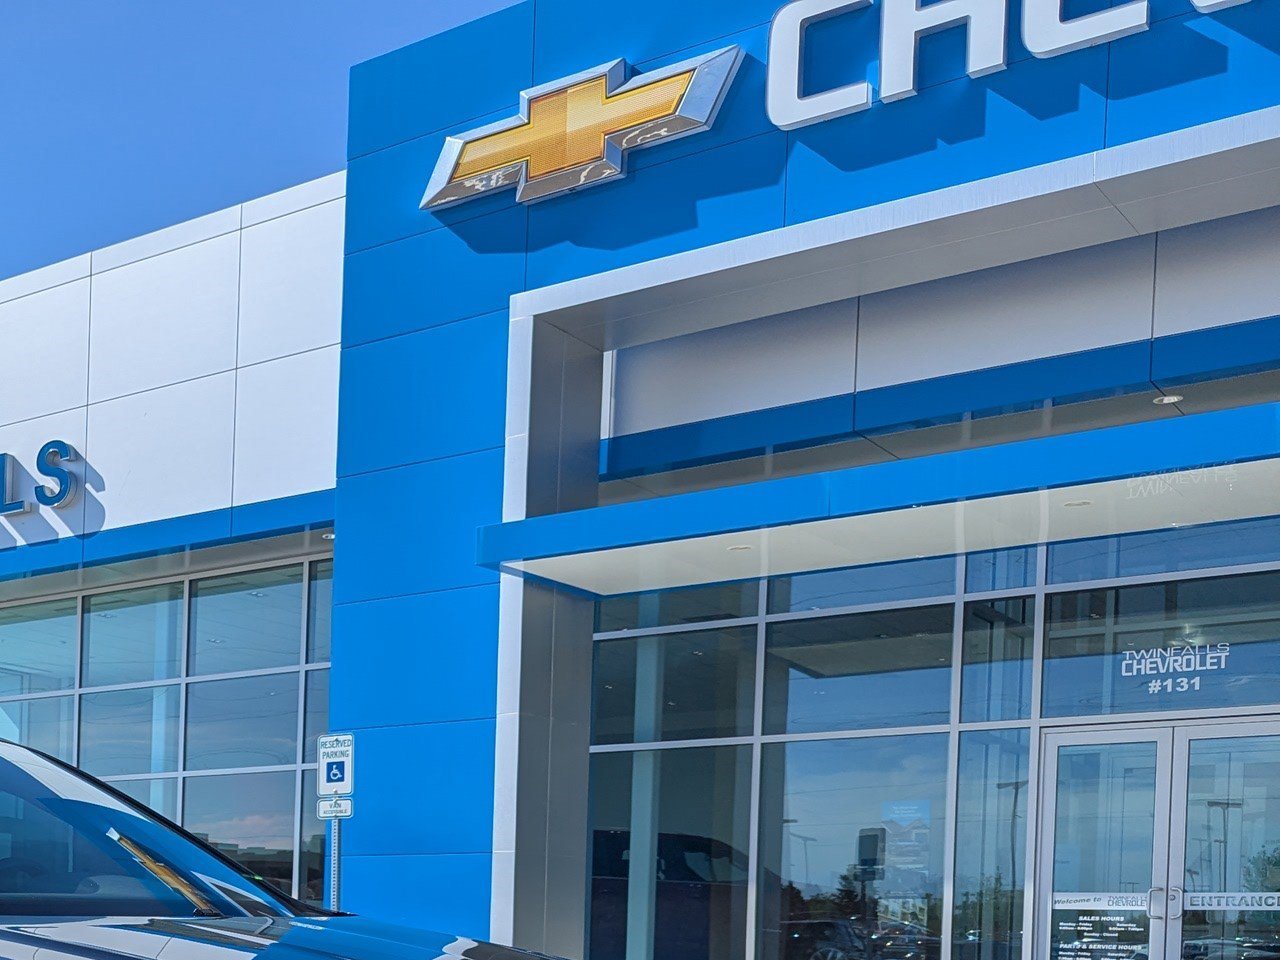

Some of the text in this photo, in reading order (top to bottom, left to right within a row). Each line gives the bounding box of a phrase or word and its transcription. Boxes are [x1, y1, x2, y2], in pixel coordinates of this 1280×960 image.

[1121, 652, 1230, 676] CHEVROLET
[1148, 676, 1201, 694] #131
[320, 739, 352, 749] RESERVED
[322, 750, 350, 760] PARKING
[1053, 897, 1091, 905] Welcome
[1189, 895, 1280, 907] ENTRANC
